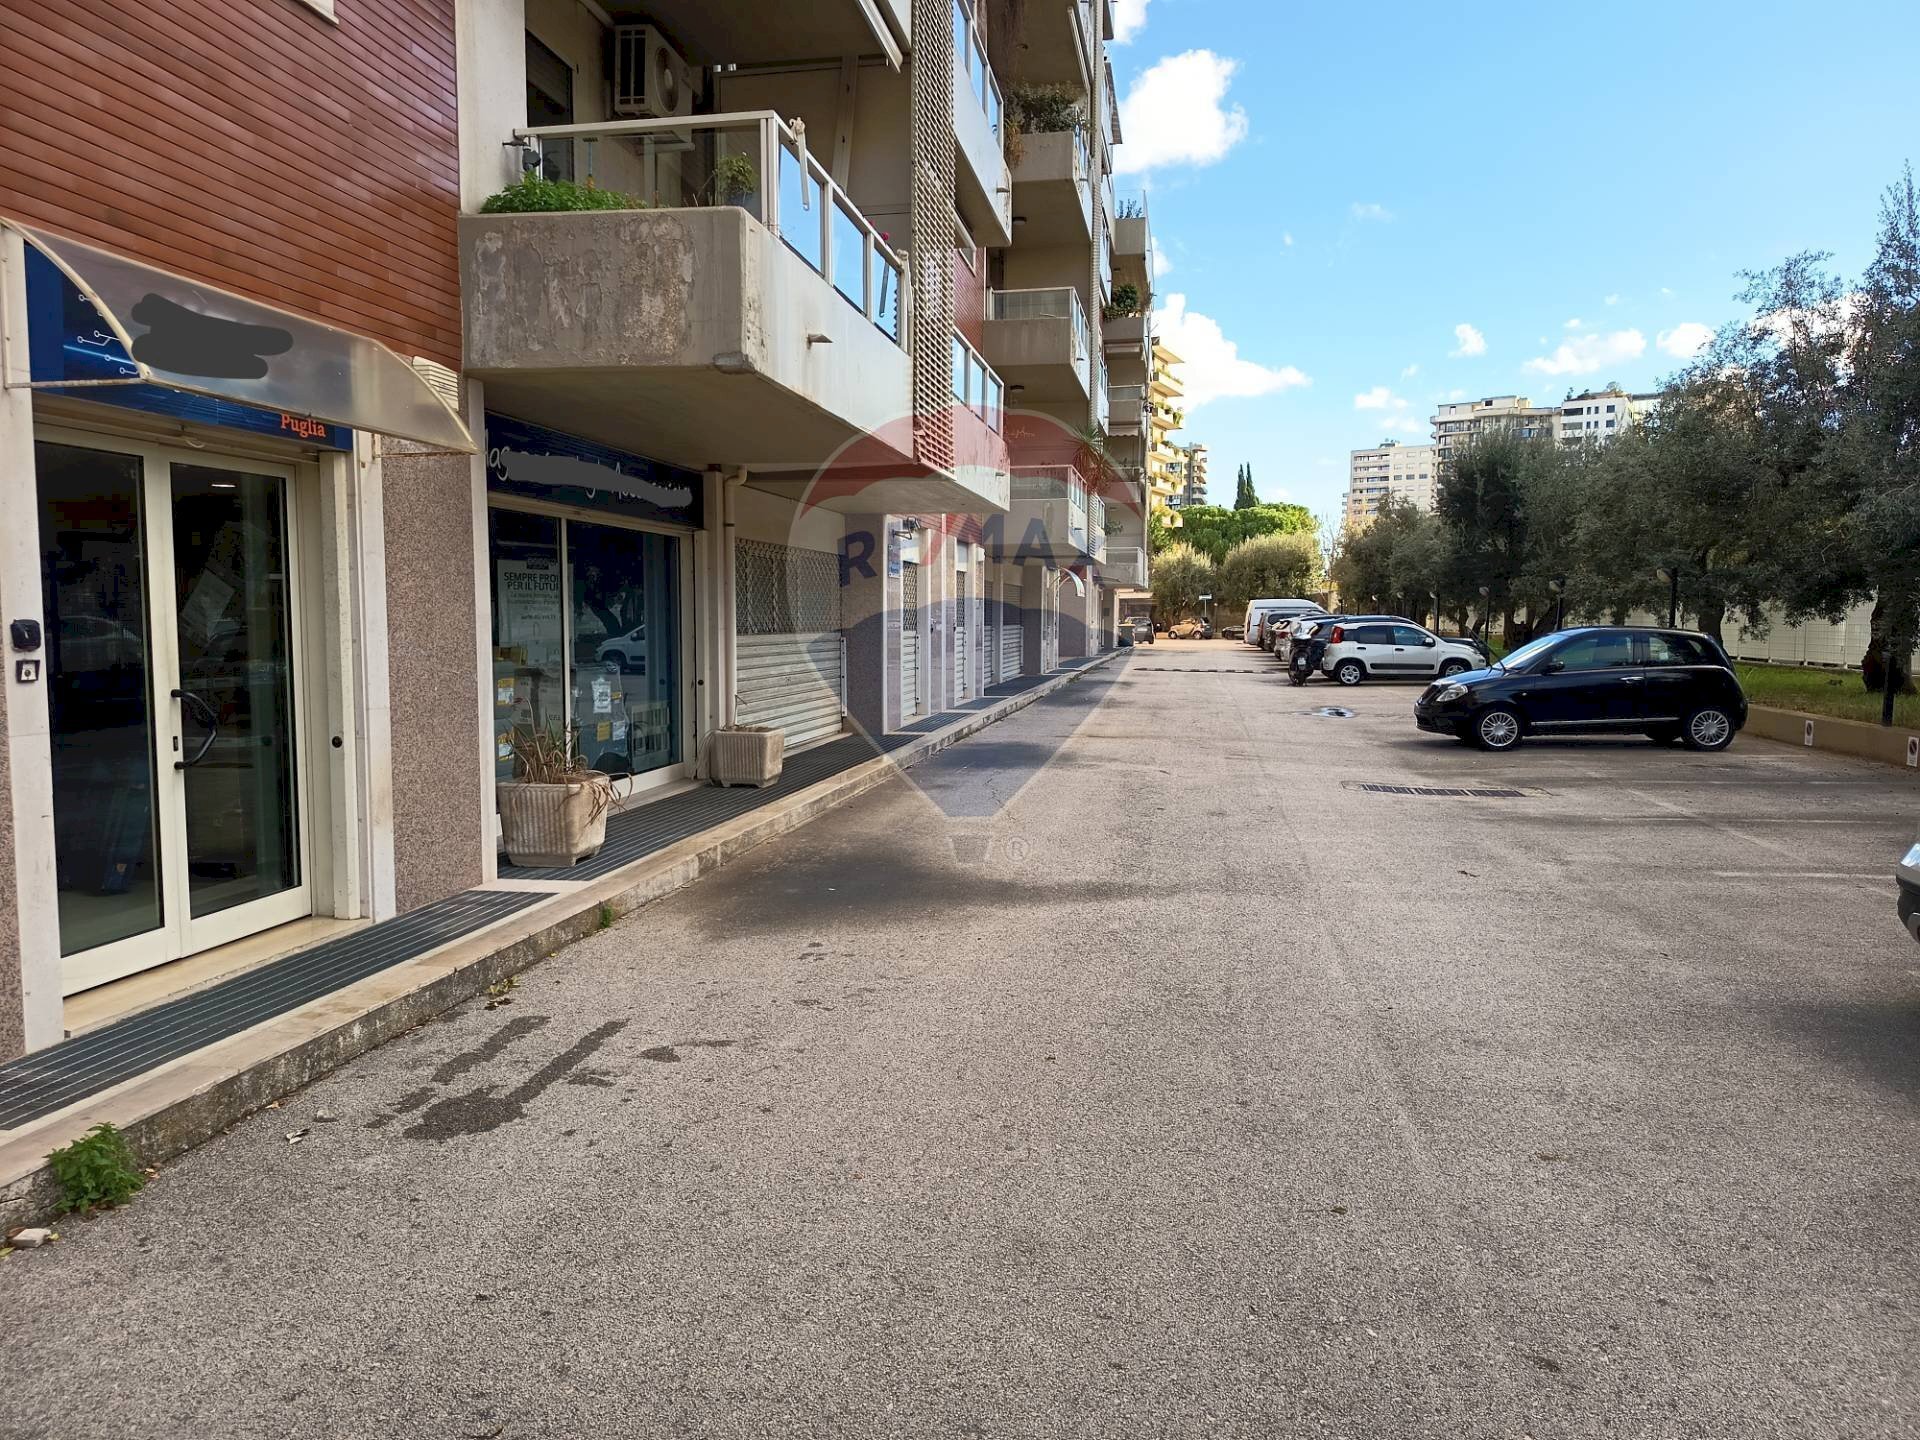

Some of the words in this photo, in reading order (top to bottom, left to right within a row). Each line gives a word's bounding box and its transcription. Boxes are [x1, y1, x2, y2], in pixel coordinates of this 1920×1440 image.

[281, 413, 326, 438] Puglia
[503, 572, 537, 582] SEMPRE
[539, 574, 559, 583] PRO
[507, 581, 523, 590] PER
[534, 582, 559, 591] FUTU
